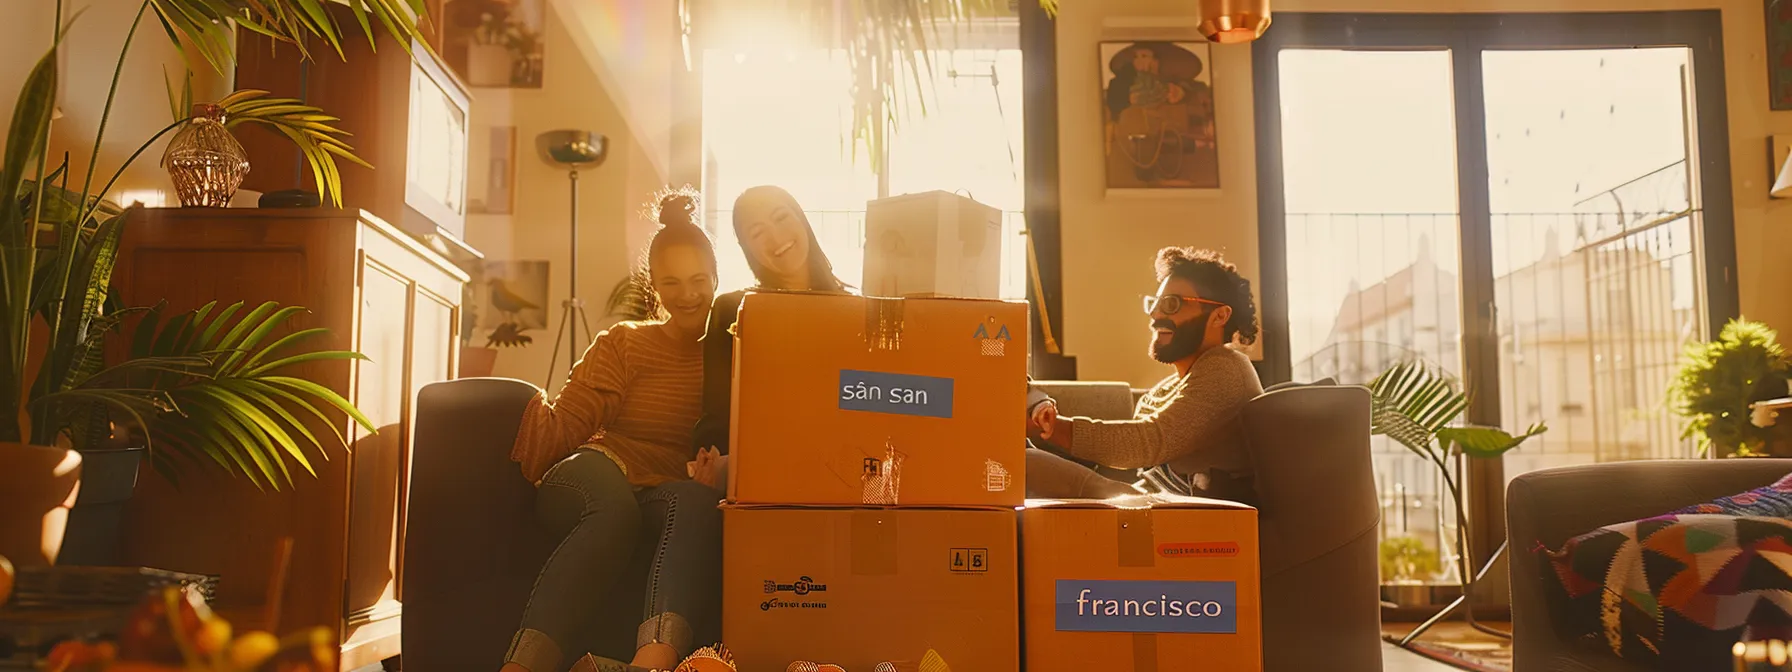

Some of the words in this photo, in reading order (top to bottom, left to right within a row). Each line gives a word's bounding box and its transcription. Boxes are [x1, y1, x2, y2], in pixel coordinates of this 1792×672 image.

[842, 381, 881, 401] sân
[889, 387, 928, 405] san
[1076, 588, 1222, 617] francisco
